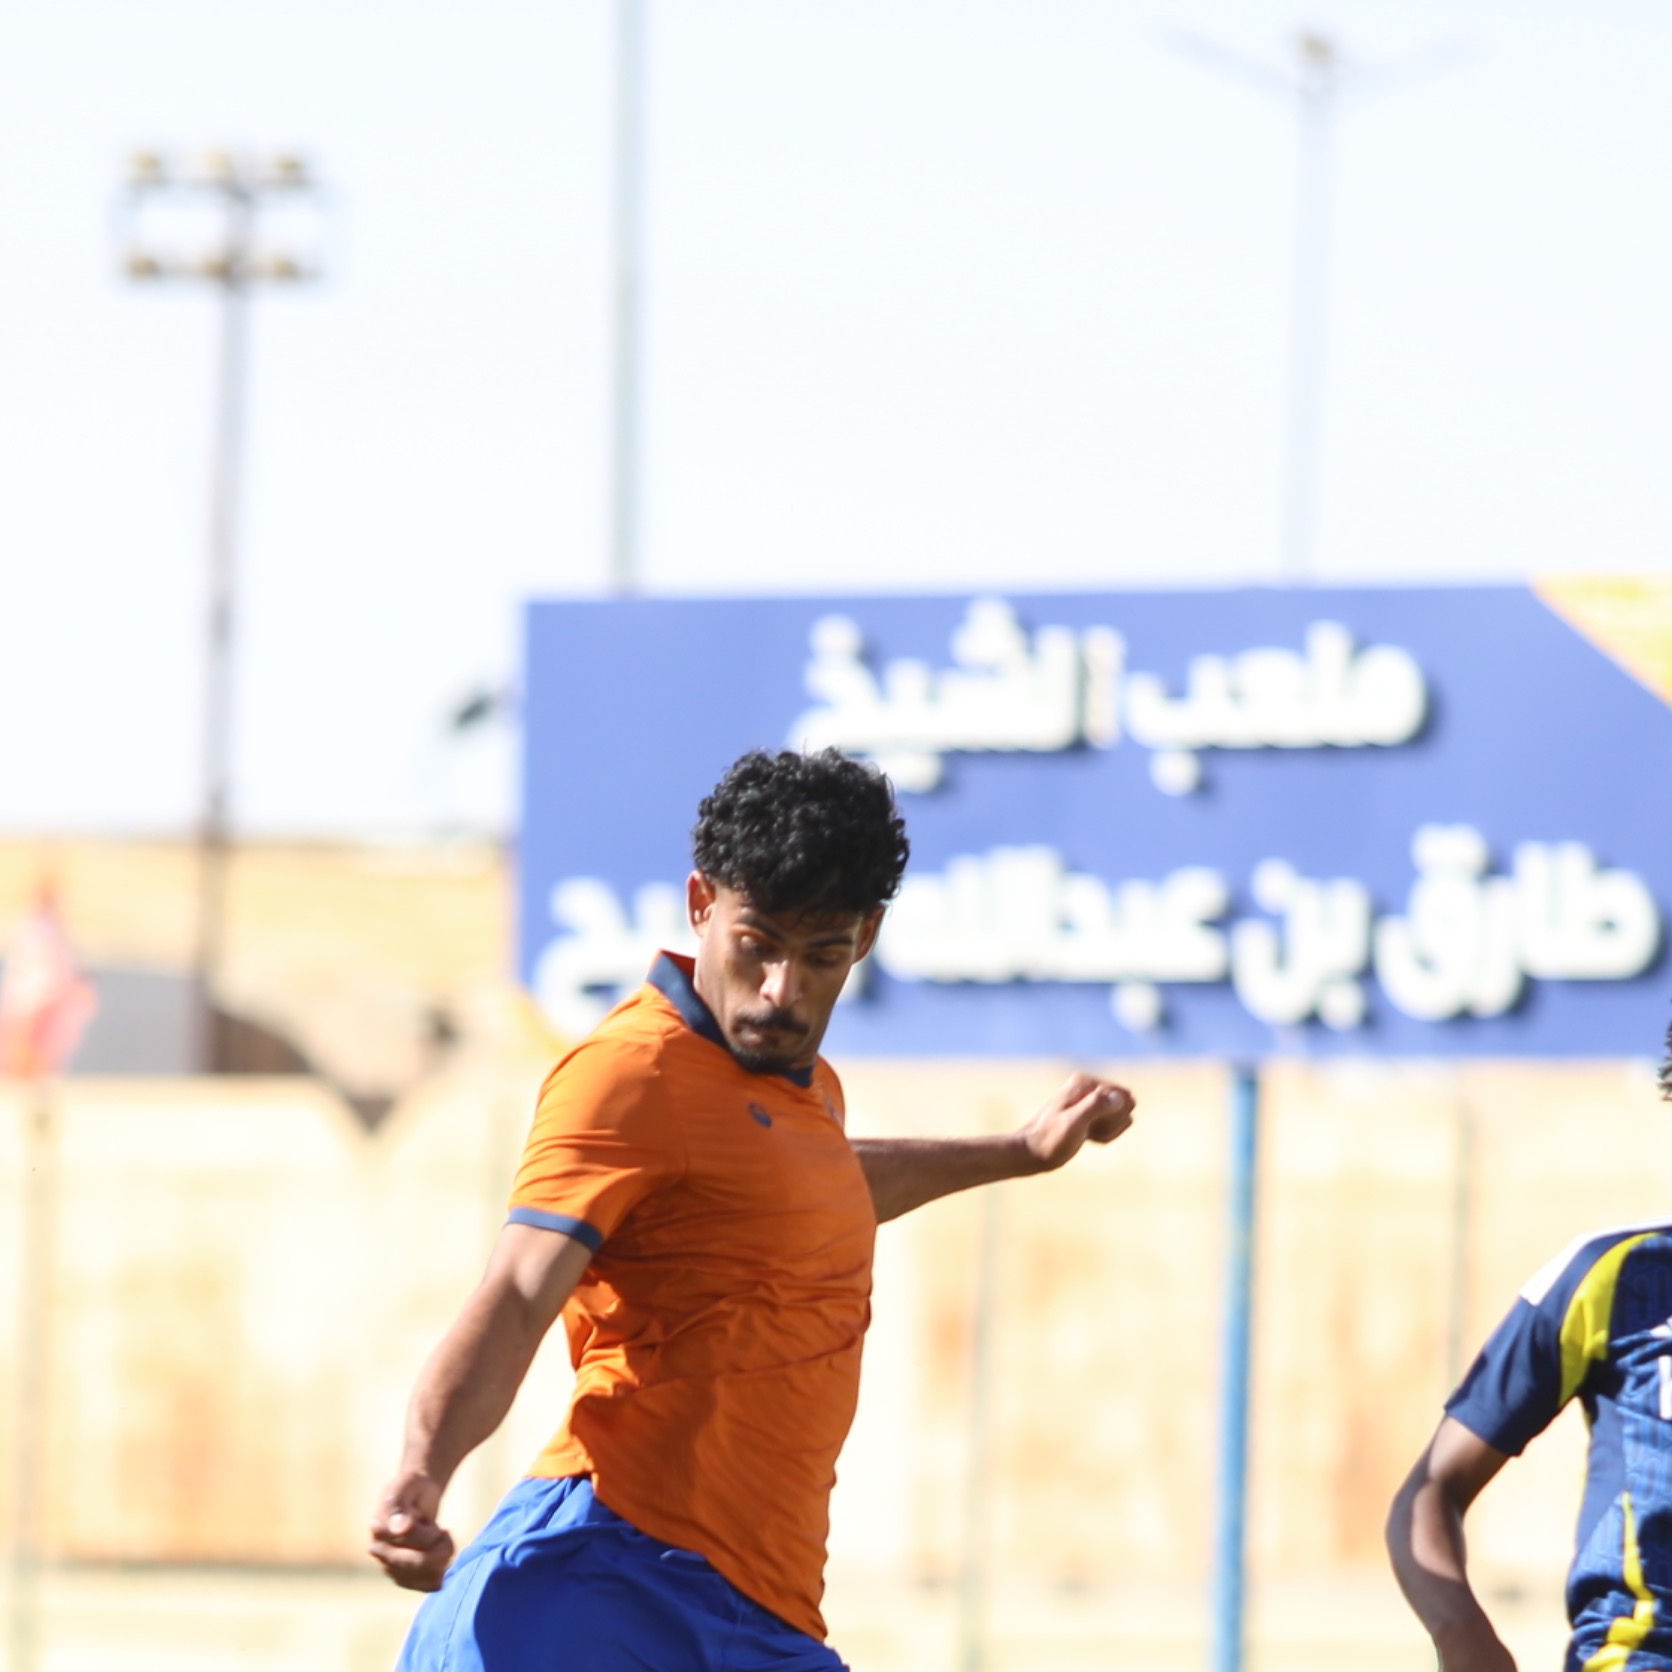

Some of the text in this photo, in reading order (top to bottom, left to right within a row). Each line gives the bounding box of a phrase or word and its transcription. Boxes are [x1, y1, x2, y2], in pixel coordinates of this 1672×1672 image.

[791, 596, 1422, 796] ملعب الشيخ
[878, 846, 1226, 1029] عبدالله
[1231, 857, 1371, 1030] بن
[1374, 824, 1660, 1020] طارق
